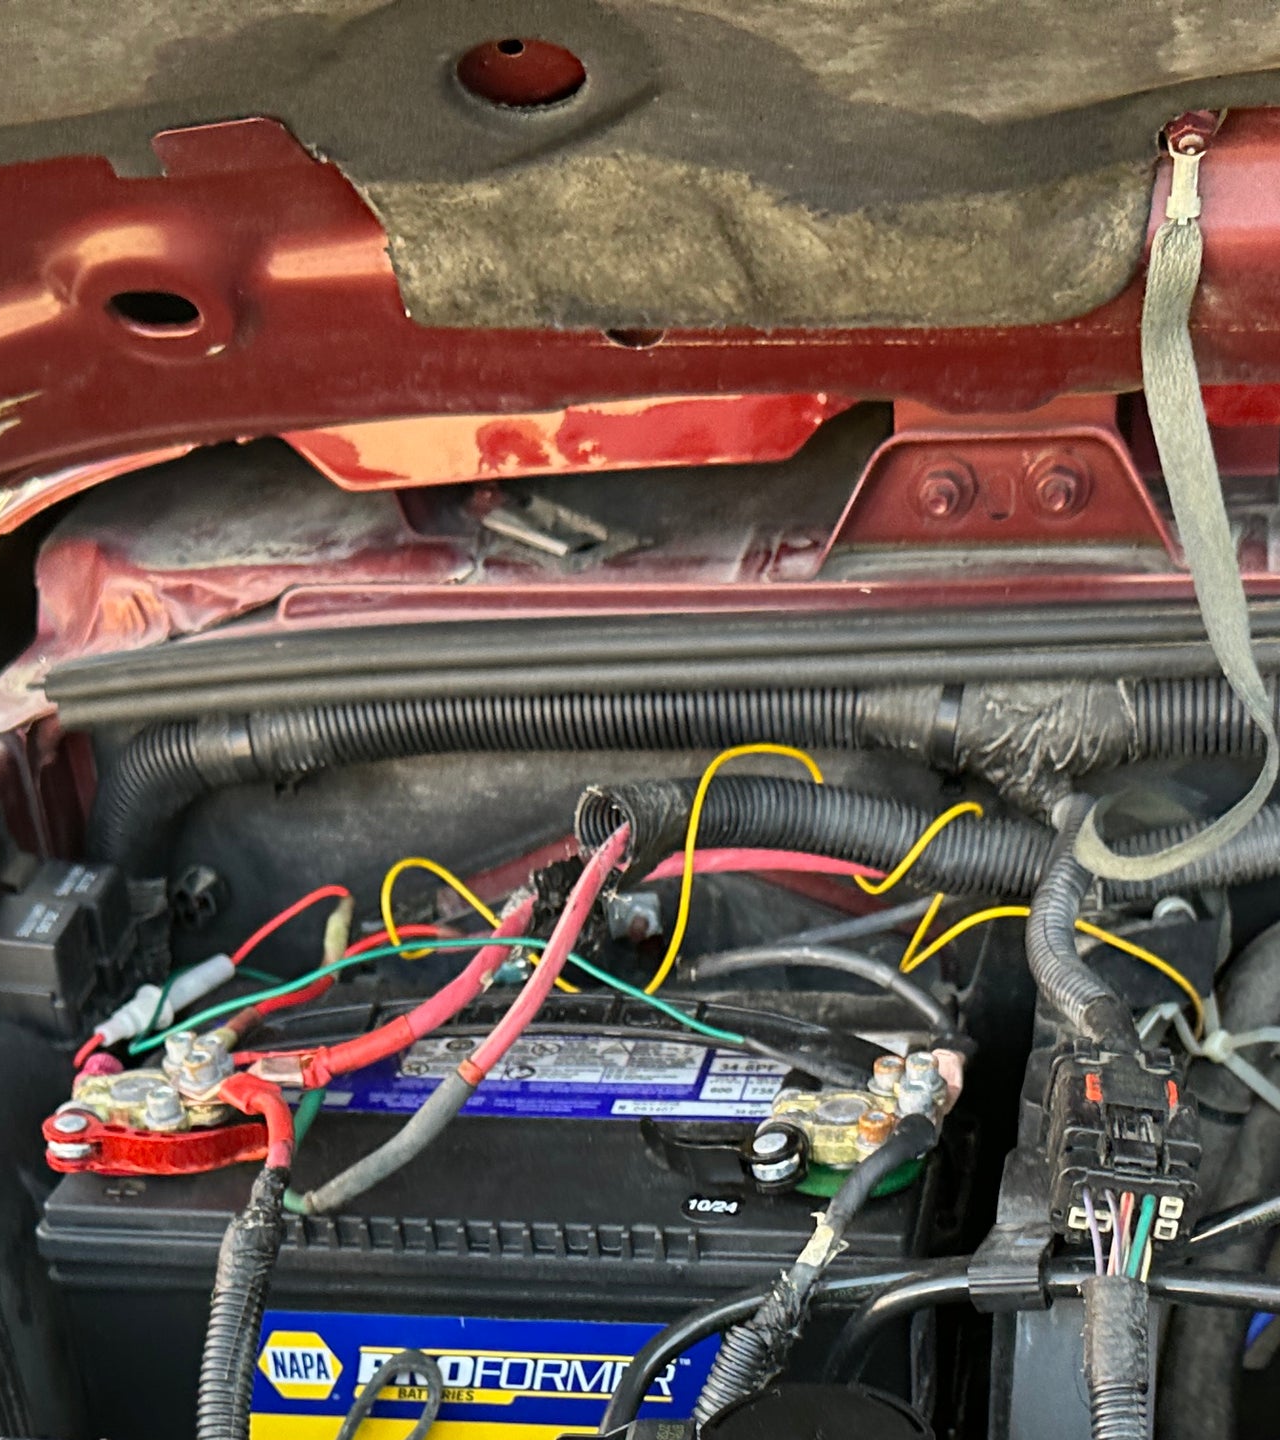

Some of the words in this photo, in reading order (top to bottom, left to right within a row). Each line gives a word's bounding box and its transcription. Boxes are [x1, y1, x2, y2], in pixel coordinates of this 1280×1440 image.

[688, 1198, 739, 1214] 10/24
[271, 1351, 330, 1381] NAPA
[397, 1385, 475, 1403] BATRIES
